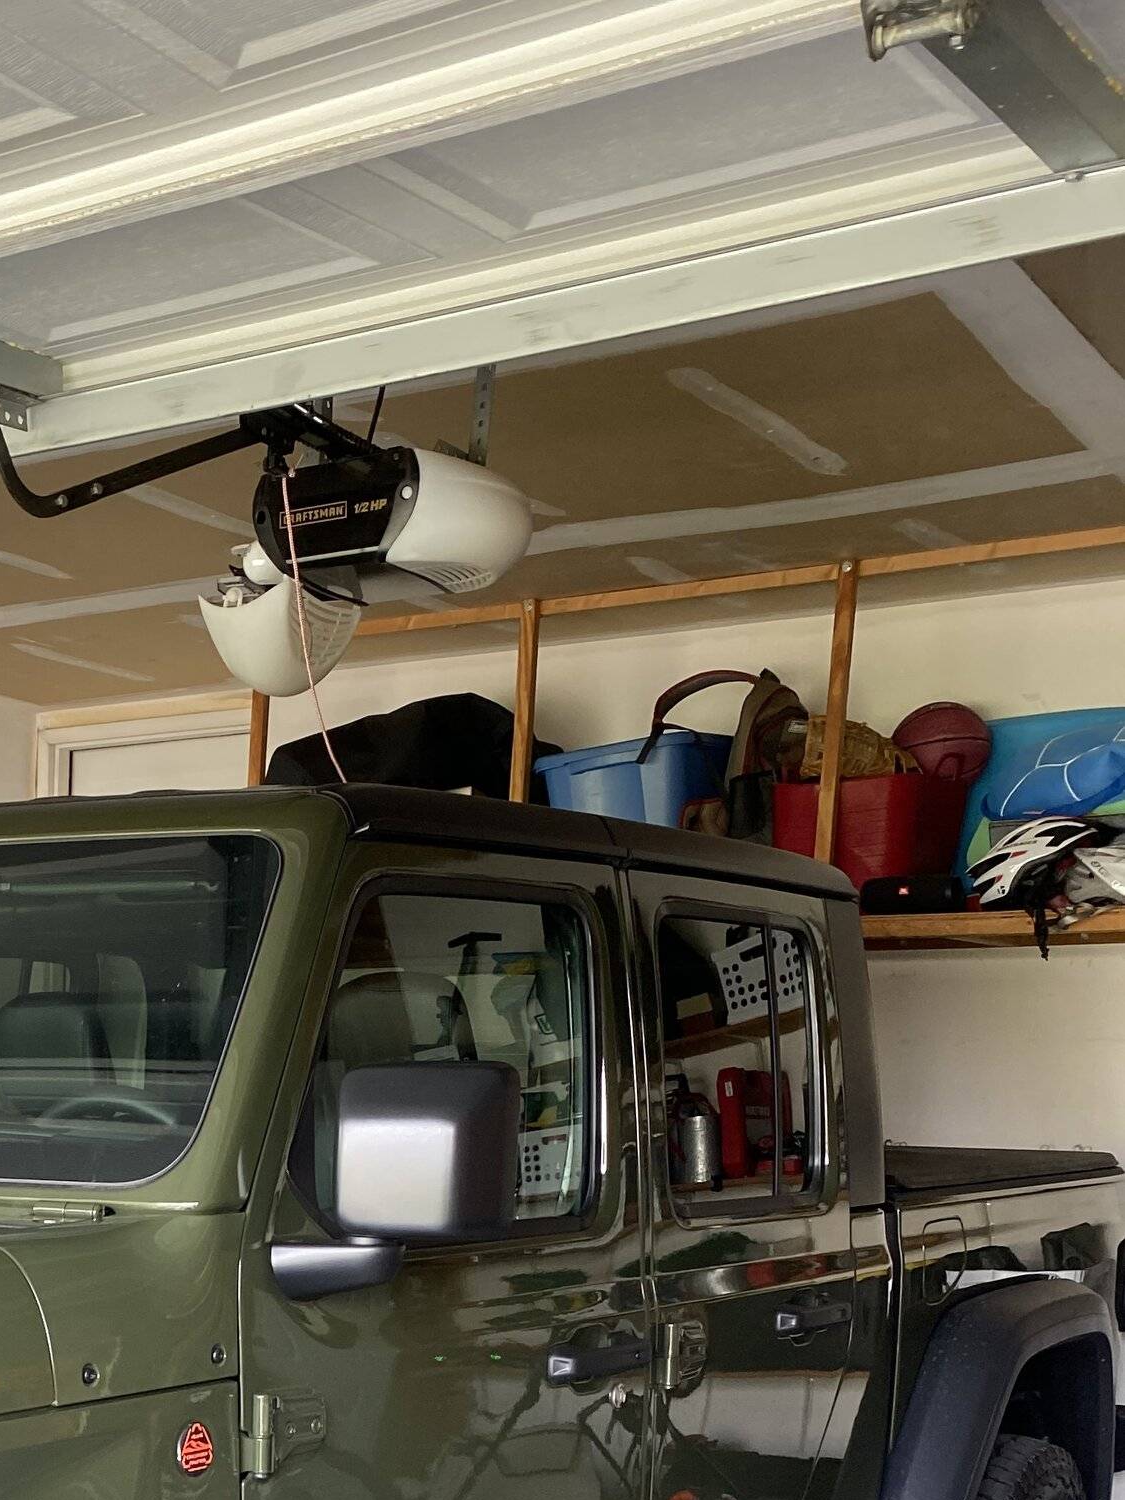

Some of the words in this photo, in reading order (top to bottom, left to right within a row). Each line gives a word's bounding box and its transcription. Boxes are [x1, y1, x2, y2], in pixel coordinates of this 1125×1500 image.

[283, 504, 345, 525] CRAFTSMAN
[354, 501, 369, 514] 1/2
[370, 498, 388, 512] HP
